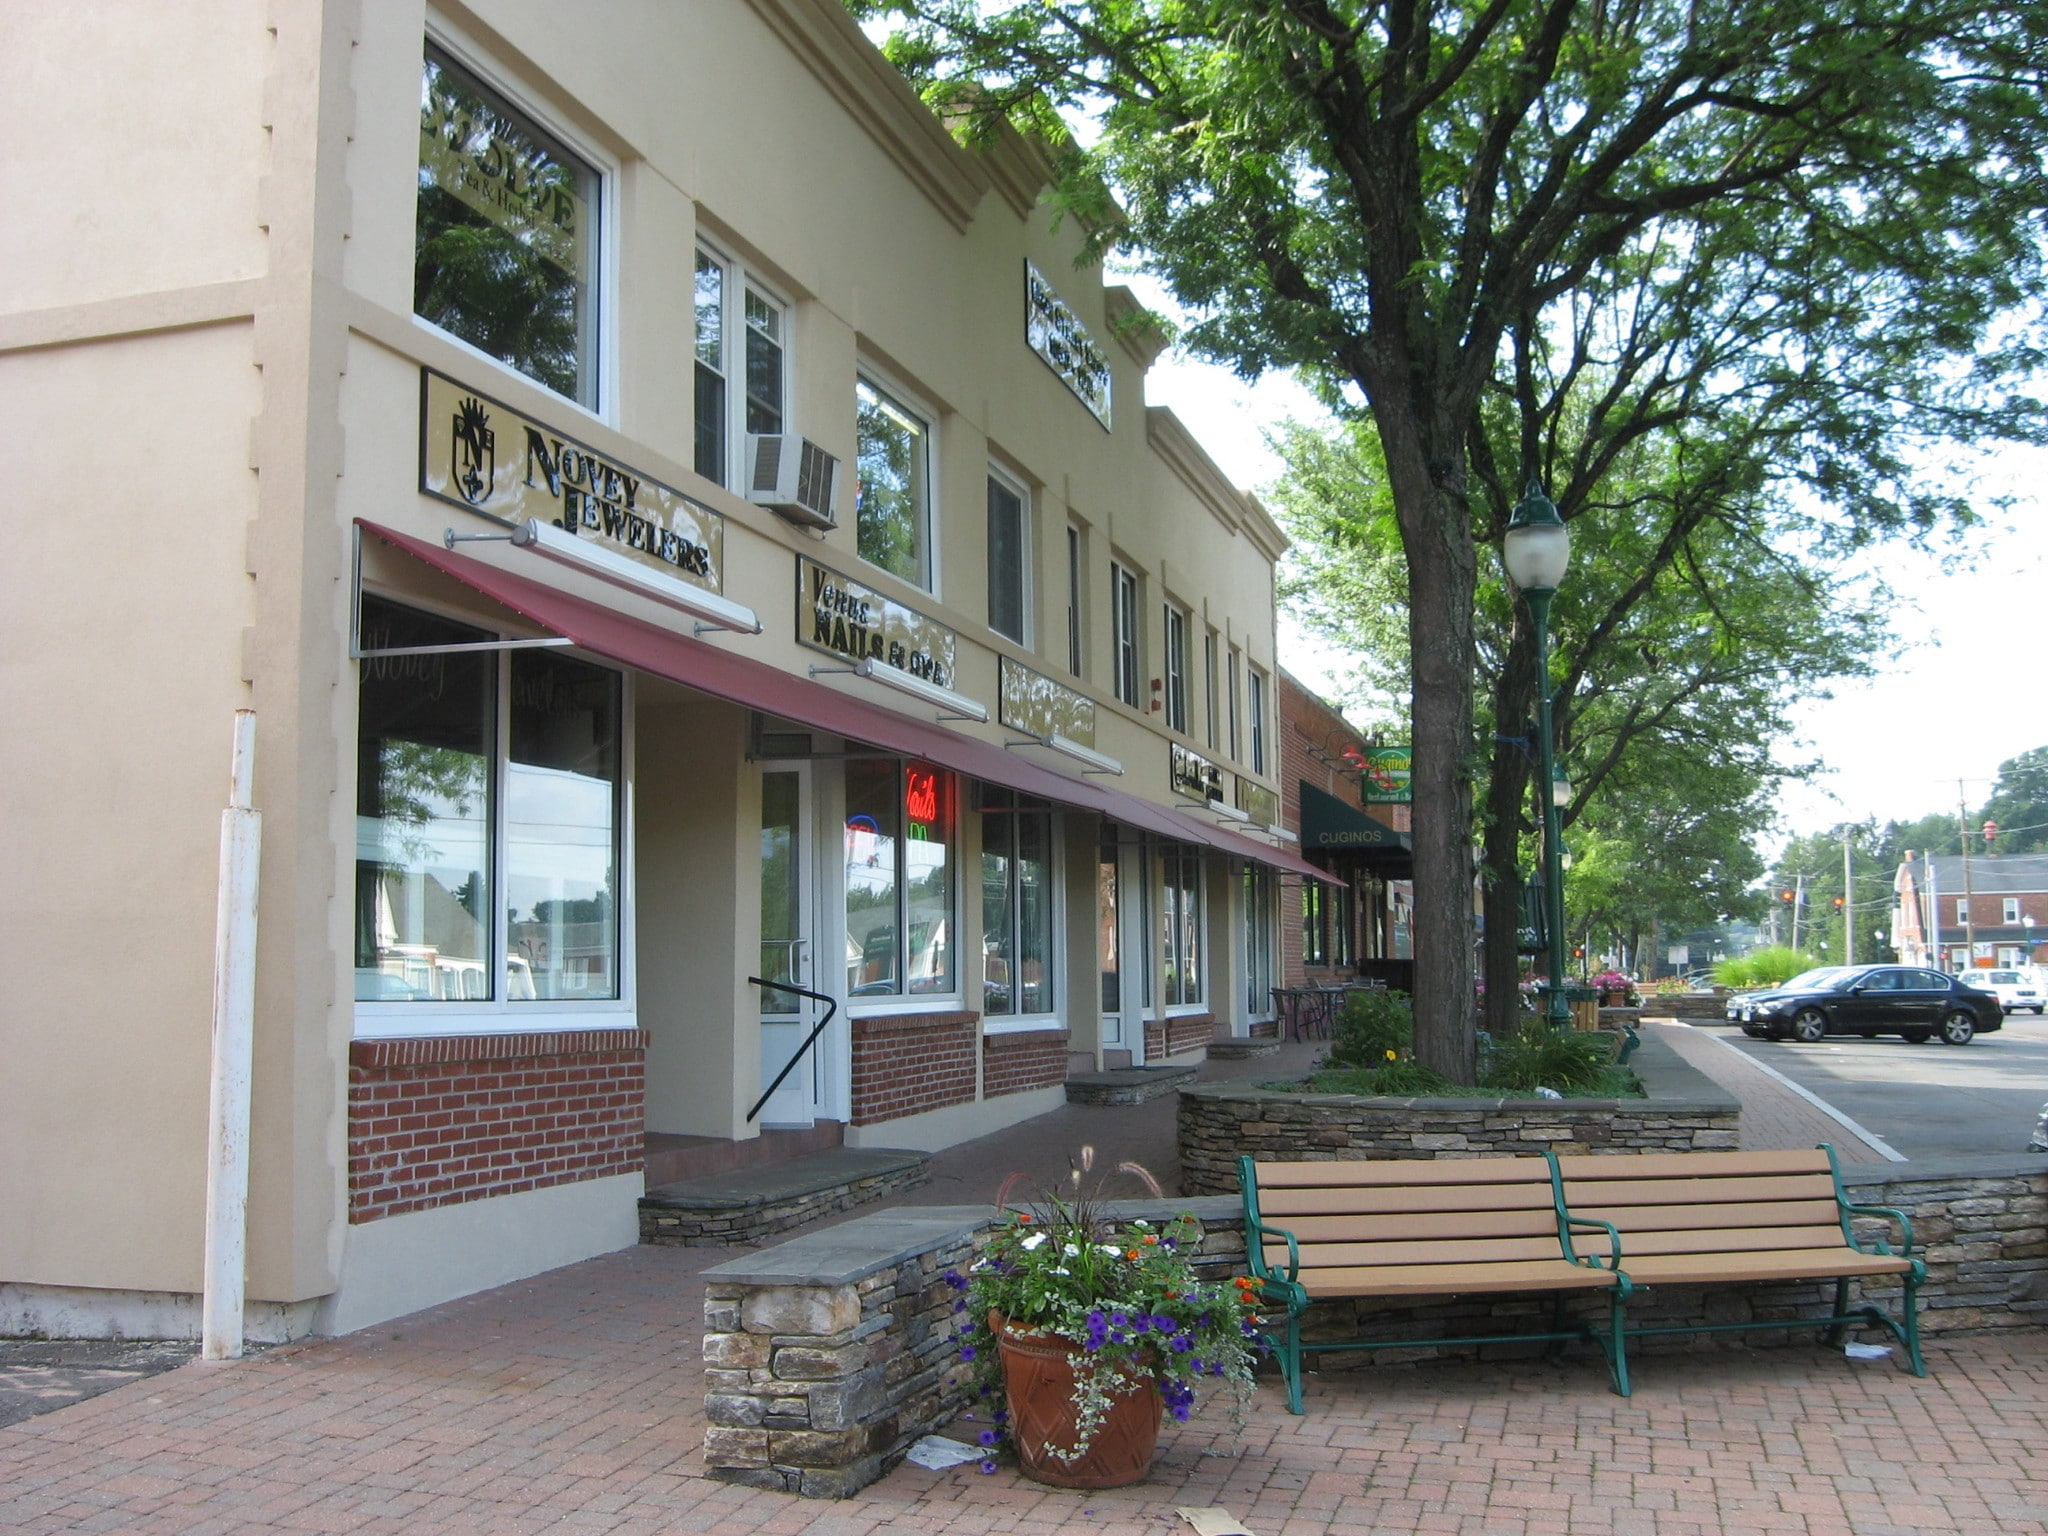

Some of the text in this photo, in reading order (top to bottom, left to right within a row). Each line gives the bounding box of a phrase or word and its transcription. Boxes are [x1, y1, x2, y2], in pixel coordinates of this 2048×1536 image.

[457, 158, 480, 193] Tea
[523, 425, 640, 512] NOVEY
[552, 482, 710, 578] JEWELERS
[813, 606, 885, 661] NAILS
[888, 640, 906, 670] &
[1319, 831, 1382, 844] CUGINOS
